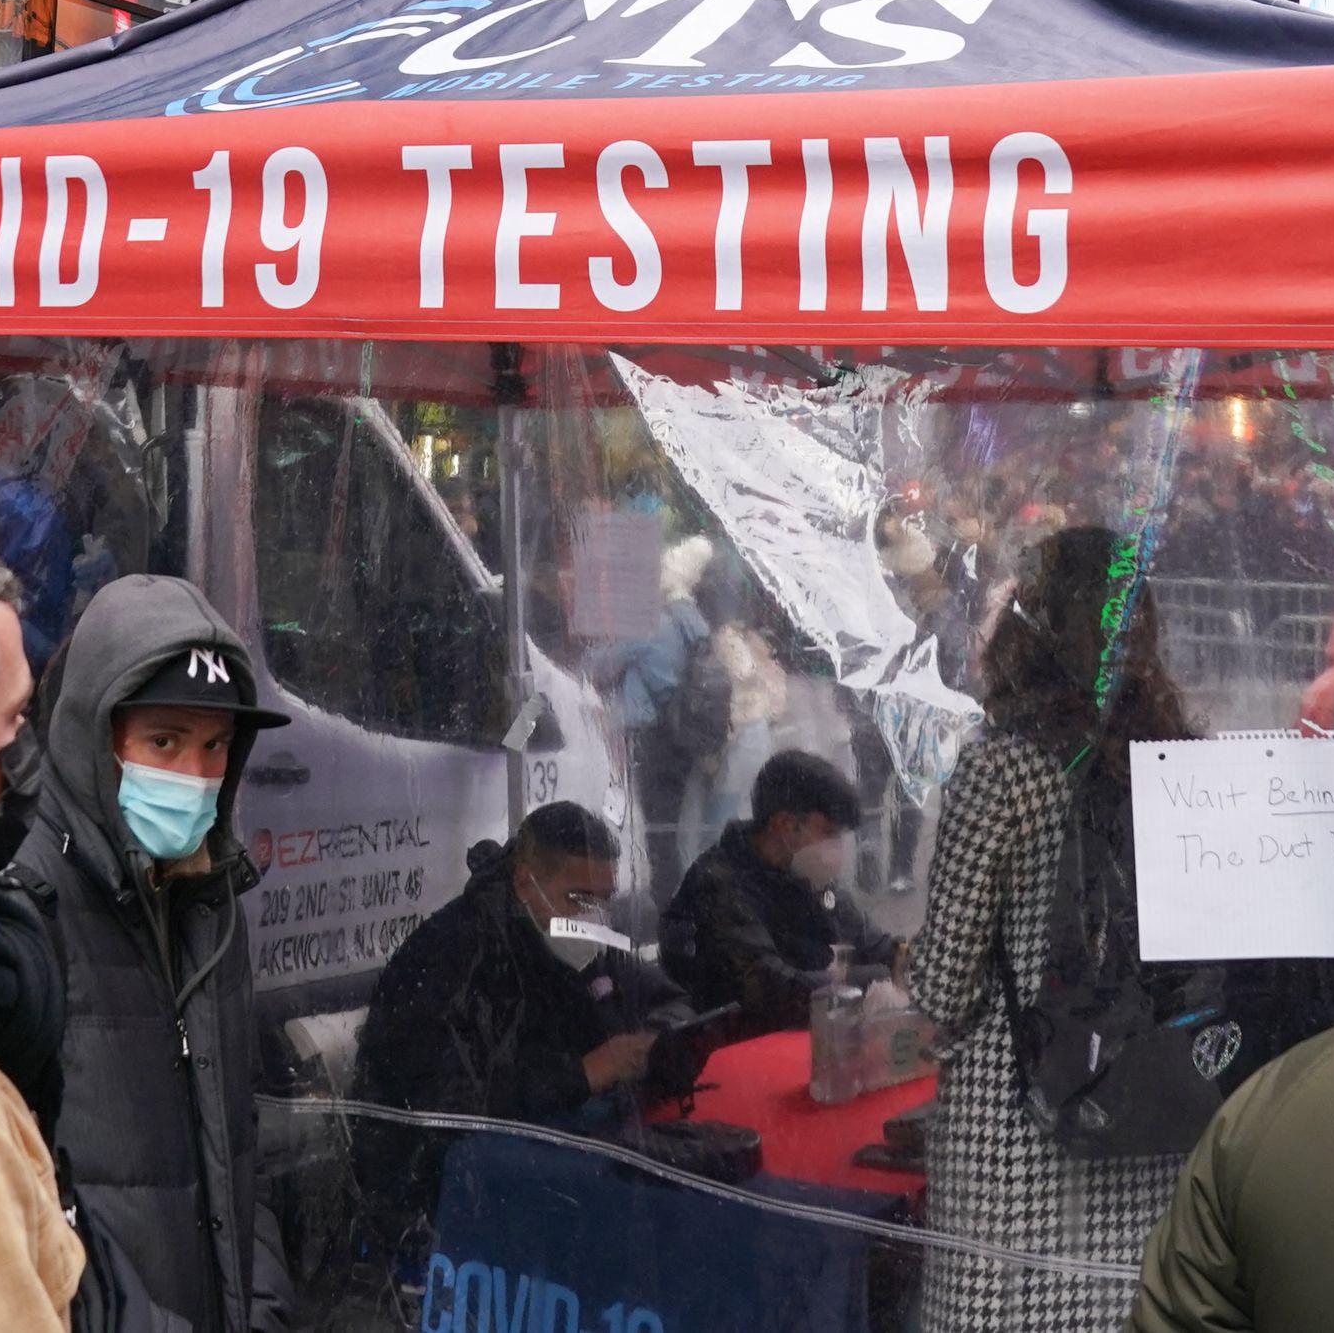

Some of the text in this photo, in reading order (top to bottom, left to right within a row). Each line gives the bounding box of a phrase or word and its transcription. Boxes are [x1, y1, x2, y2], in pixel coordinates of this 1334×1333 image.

[380, 72, 866, 100] MOBILE TESTING
[402, 132, 1074, 314] TESTING
[1161, 774, 1248, 810] Wait
[1176, 833, 1244, 874] The
[1259, 833, 1314, 864] Duct
